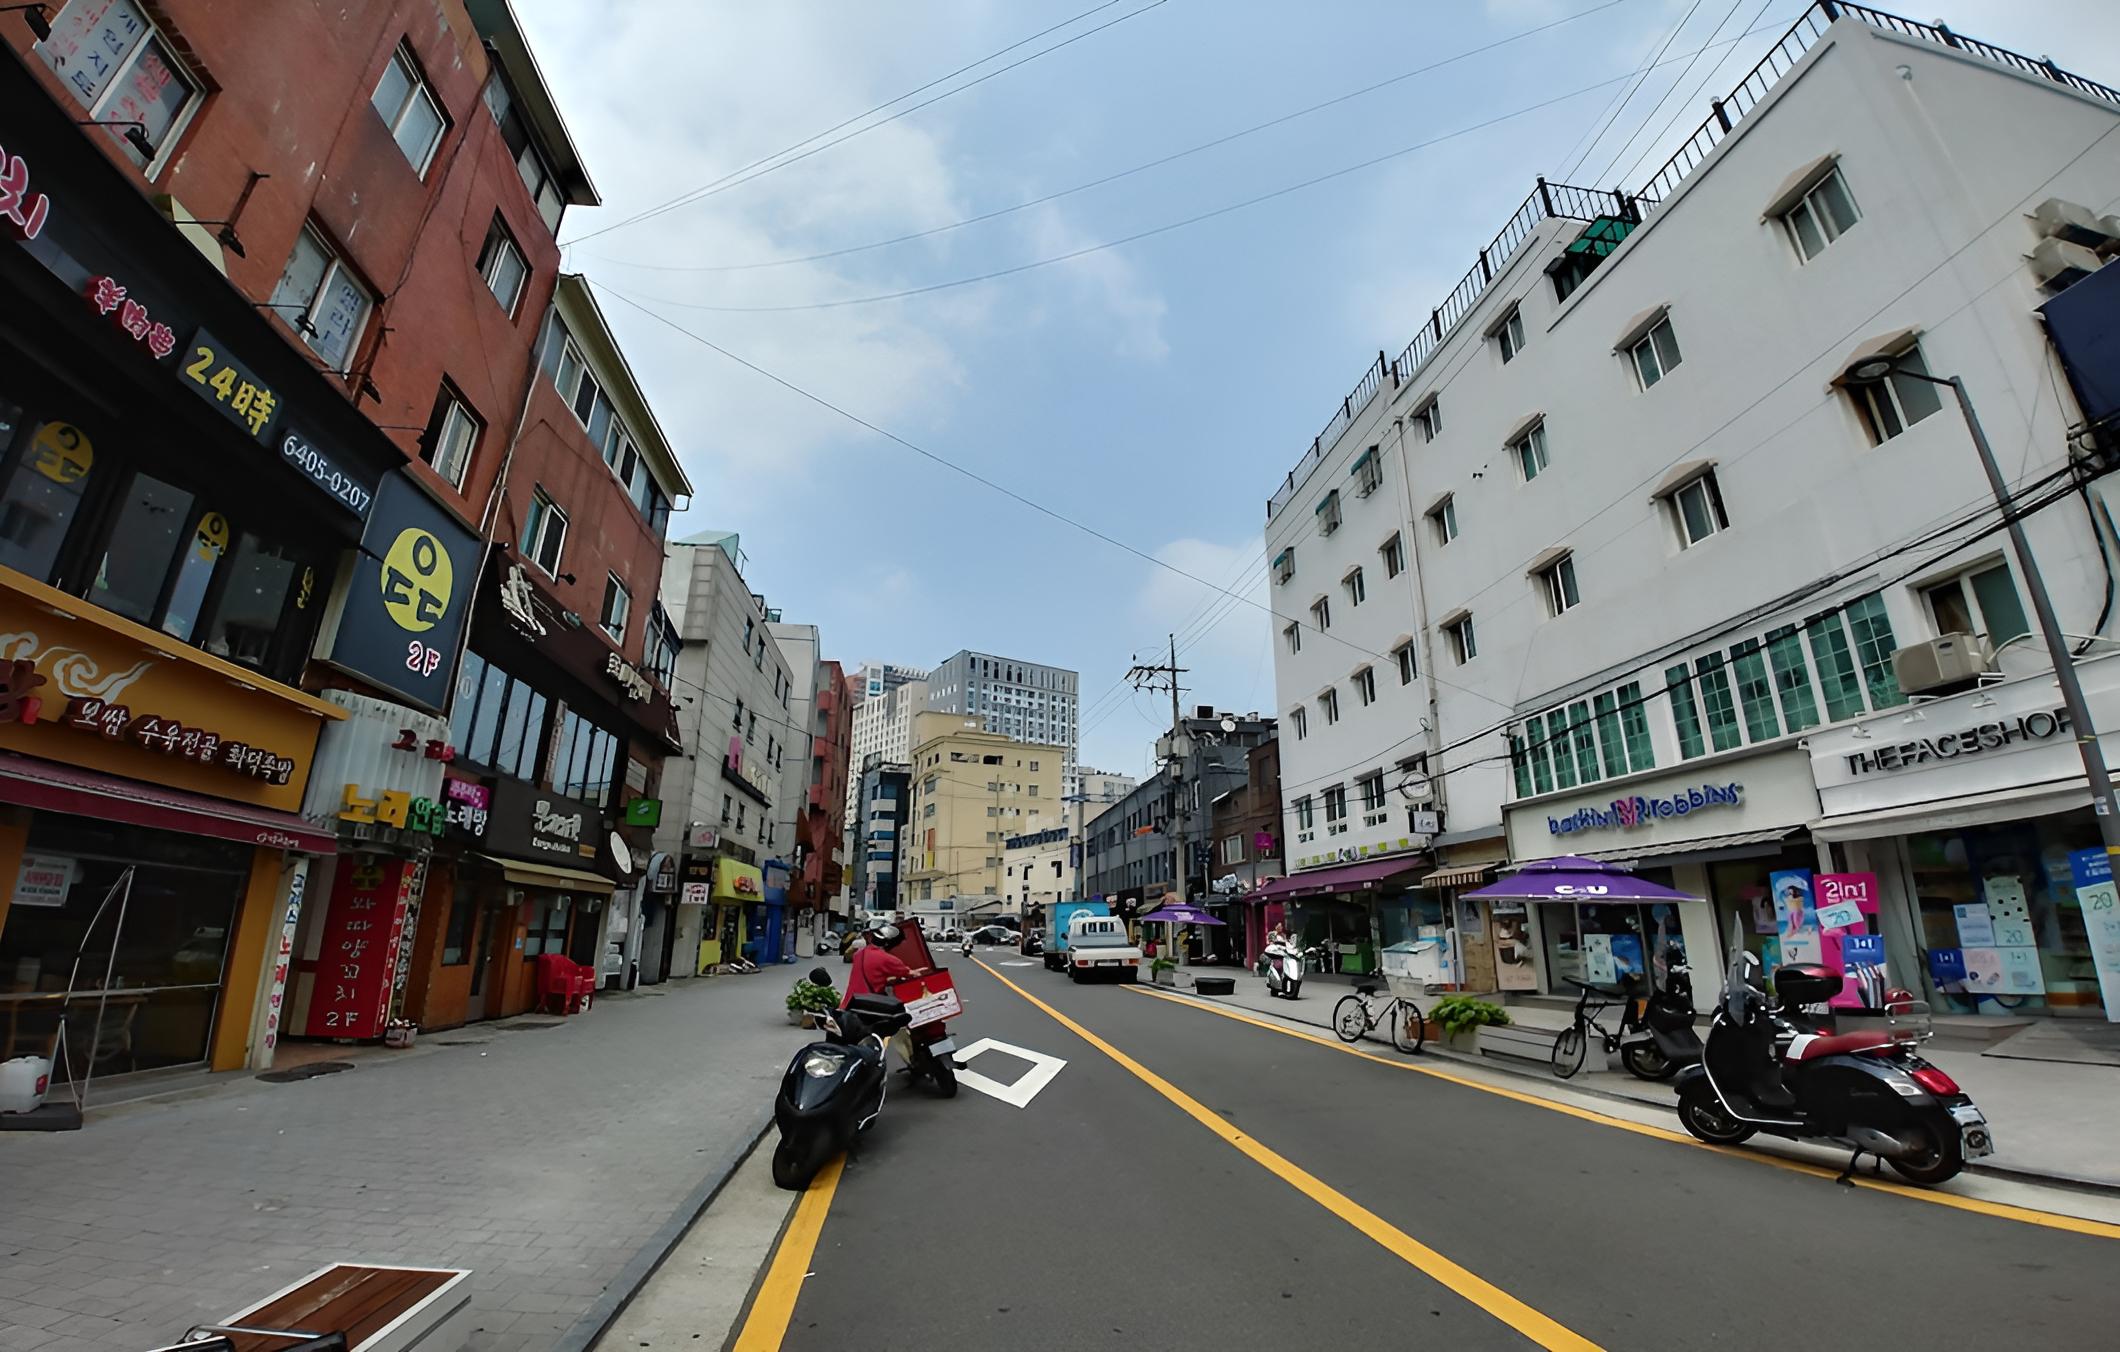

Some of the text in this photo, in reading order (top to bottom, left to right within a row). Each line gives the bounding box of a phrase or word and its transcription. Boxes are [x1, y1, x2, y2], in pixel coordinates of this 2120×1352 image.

[283, 434, 371, 512] 6405-0207
[405, 640, 441, 678] 2F
[326, 1012, 359, 1027] 2F
